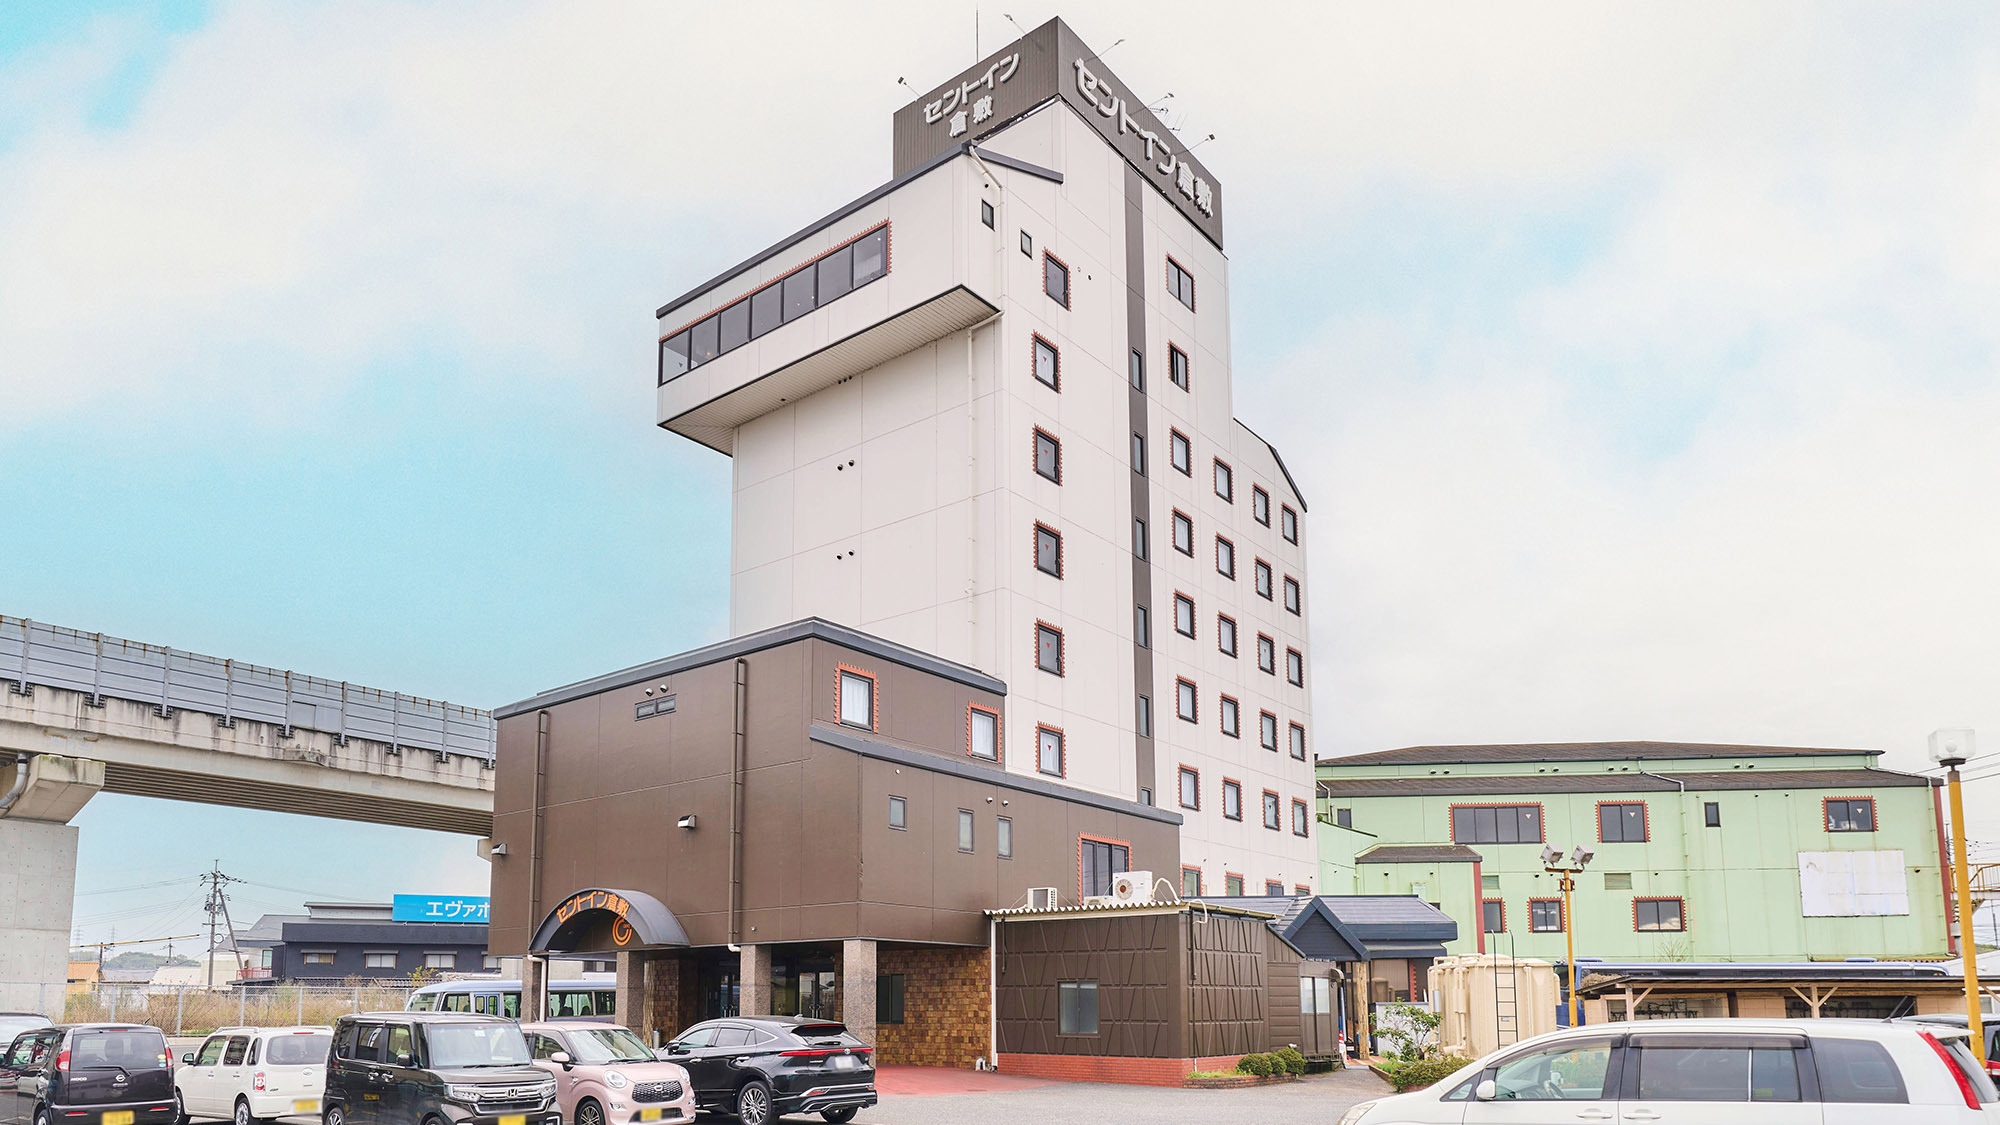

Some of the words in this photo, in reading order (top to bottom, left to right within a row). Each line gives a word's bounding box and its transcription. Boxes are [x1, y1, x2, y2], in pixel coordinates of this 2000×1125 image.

[923, 53, 1020, 124] セントイン
[949, 95, 994, 138] 倉敷
[1073, 57, 1213, 219] セントイン倉敷
[556, 890, 631, 923] セントイン倉敷
